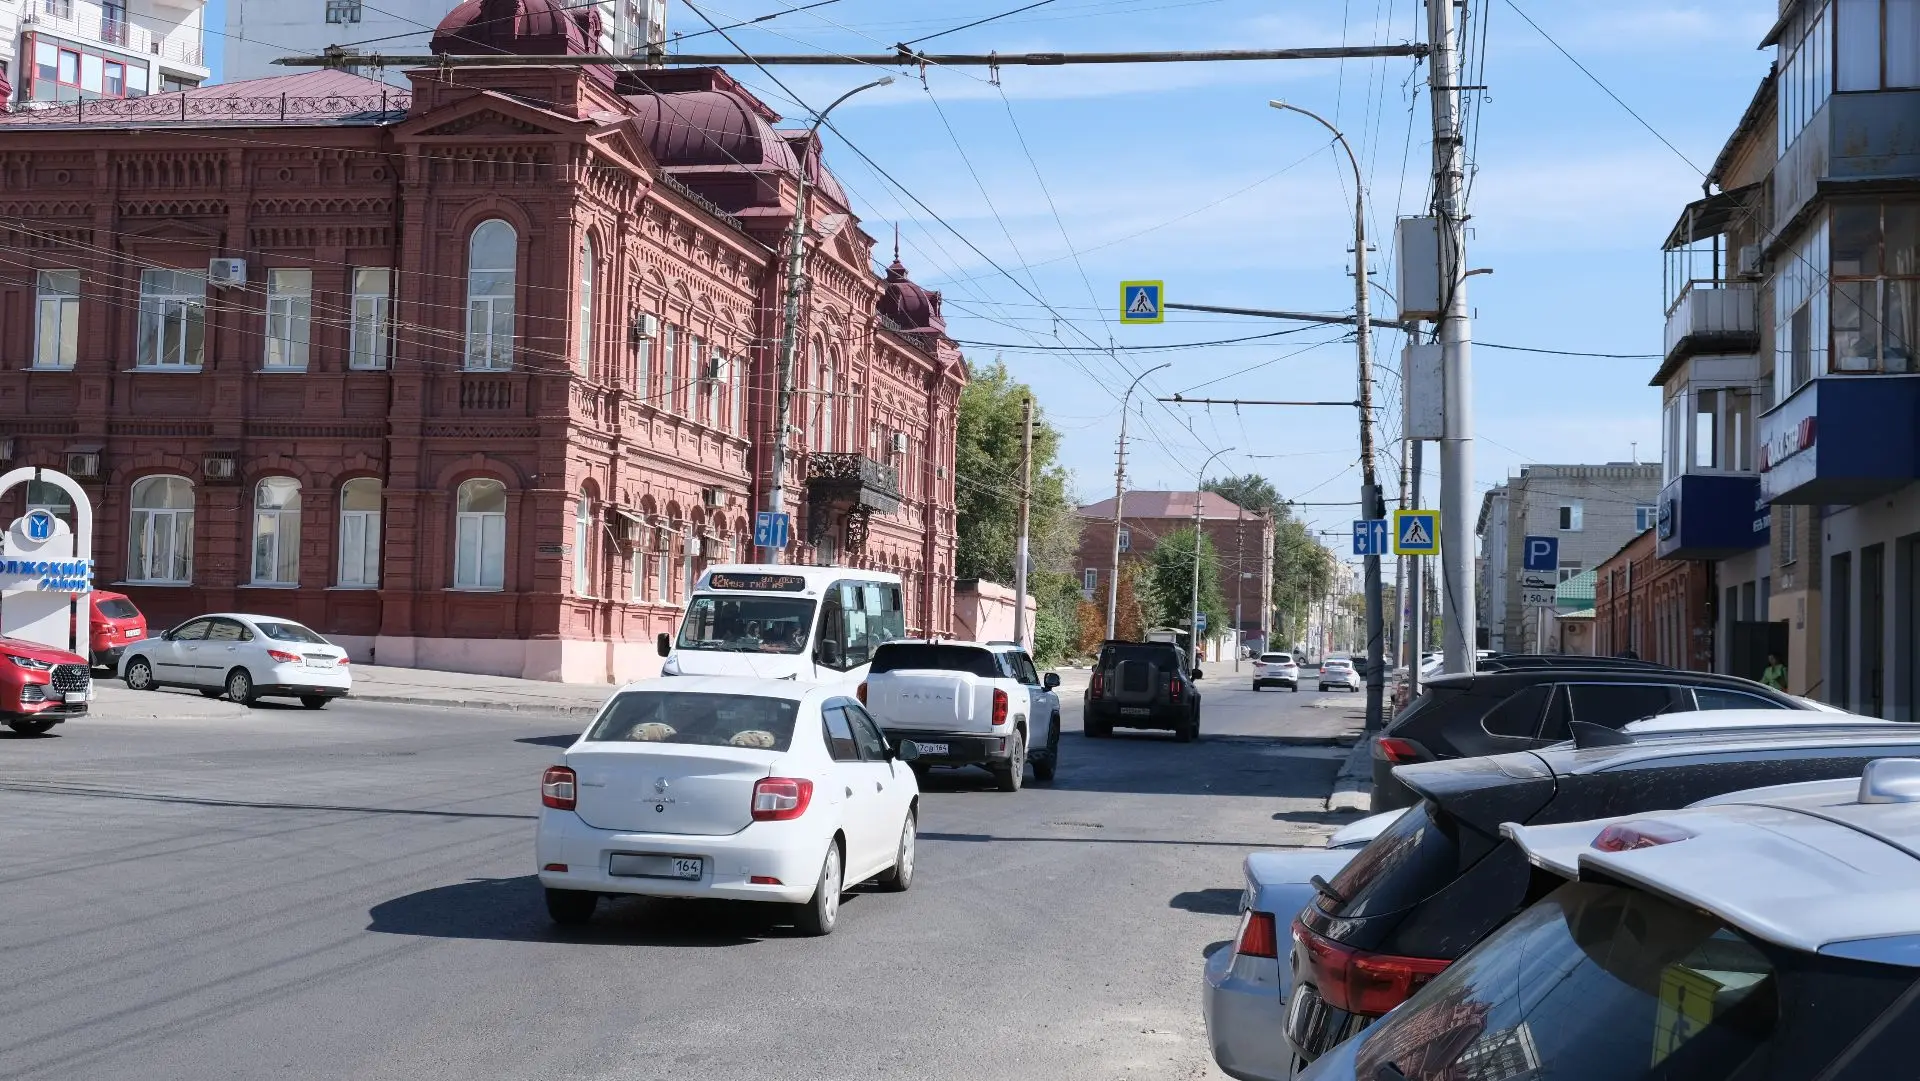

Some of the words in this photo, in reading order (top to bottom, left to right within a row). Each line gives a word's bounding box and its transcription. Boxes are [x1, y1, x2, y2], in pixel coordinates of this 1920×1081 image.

[1530, 540, 1551, 566] P
[42, 577, 86, 590] РАЙОН
[1530, 594, 1542, 603] 50
[675, 860, 699, 872] 164
